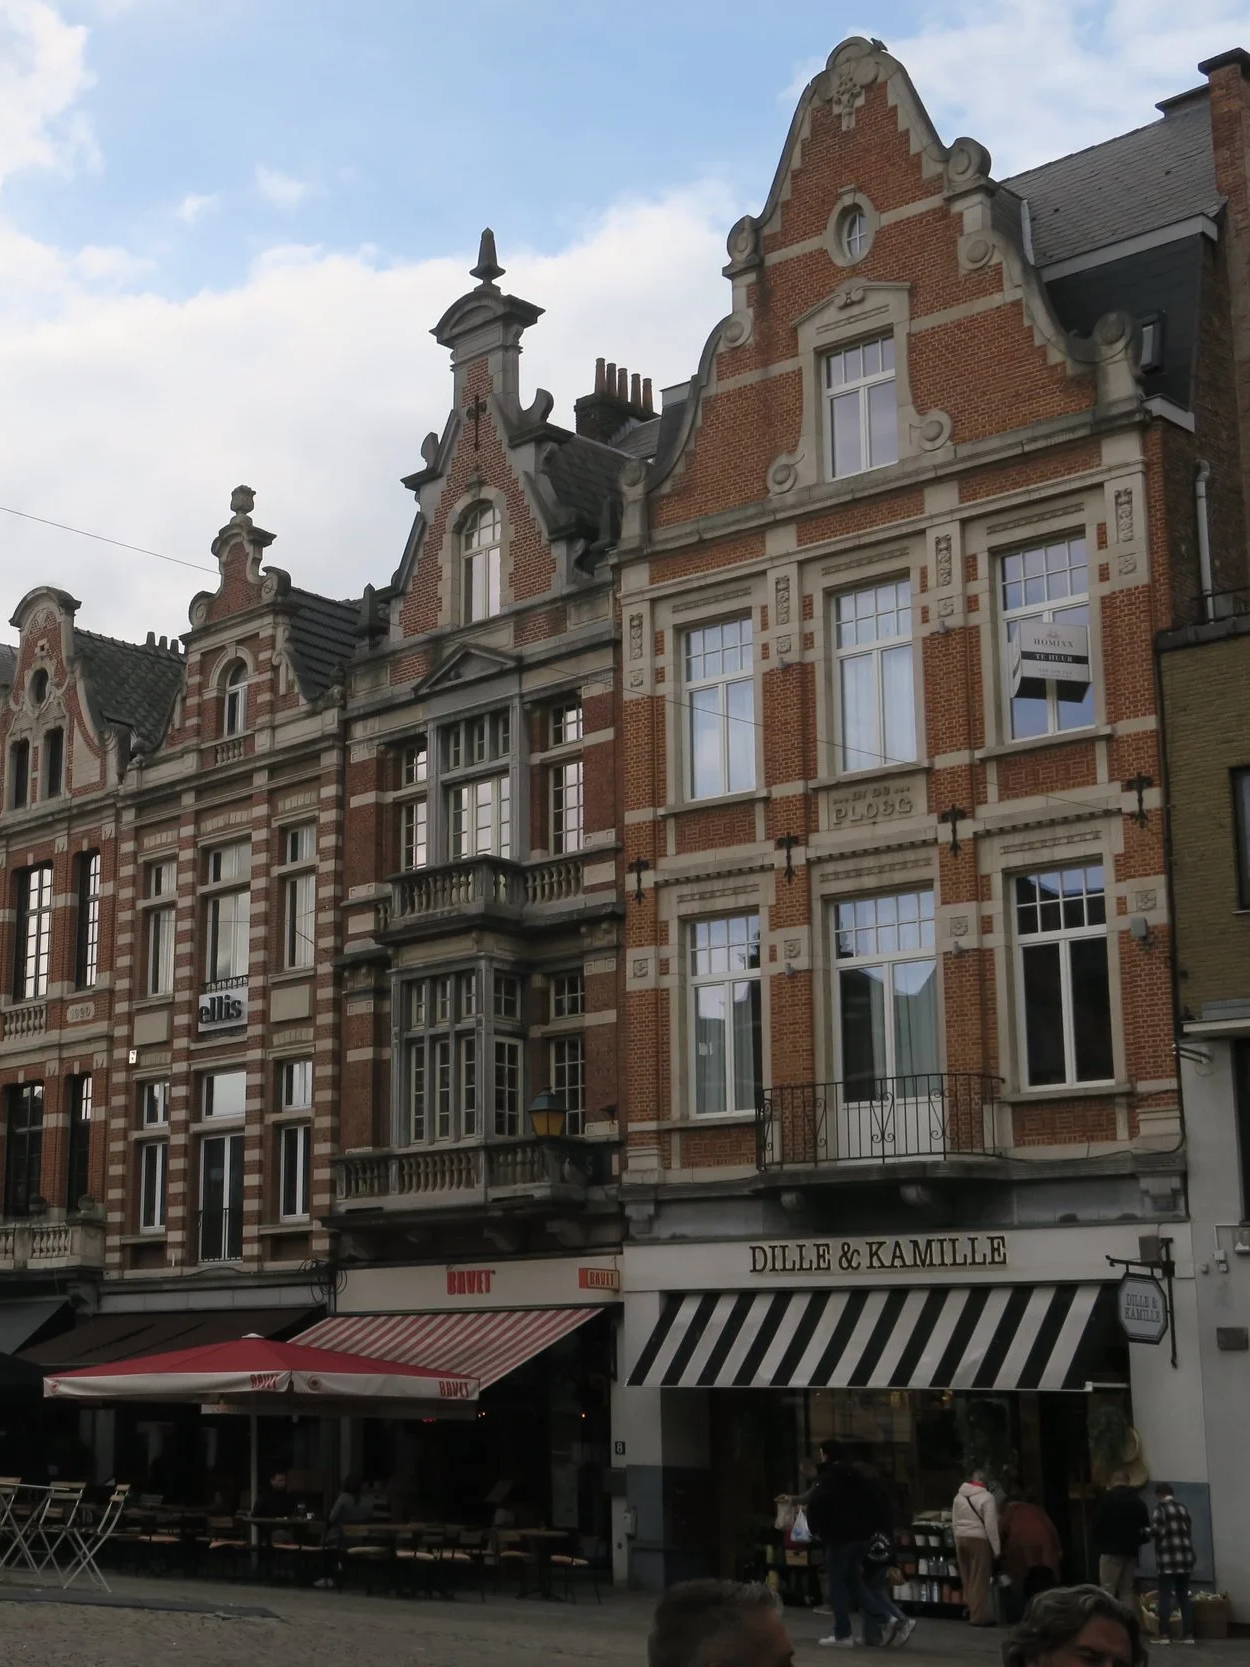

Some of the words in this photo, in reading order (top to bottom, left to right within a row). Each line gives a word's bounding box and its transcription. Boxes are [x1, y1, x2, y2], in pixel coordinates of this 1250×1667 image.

[1035, 653, 1046, 661] TE
[1048, 654, 1073, 663] HUUR
[199, 994, 242, 1024] ellis
[749, 1243, 831, 1273] DILLE
[838, 1242, 861, 1271] &
[866, 1235, 1008, 1270] KAMILLE
[447, 1270, 491, 1295] BAVET
[589, 1271, 614, 1287] BAVET
[1126, 1293, 1150, 1308] DILLE
[1152, 1297, 1159, 1309] &
[1124, 1307, 1161, 1323] KAMILLE
[438, 1381, 470, 1398] BAVET
